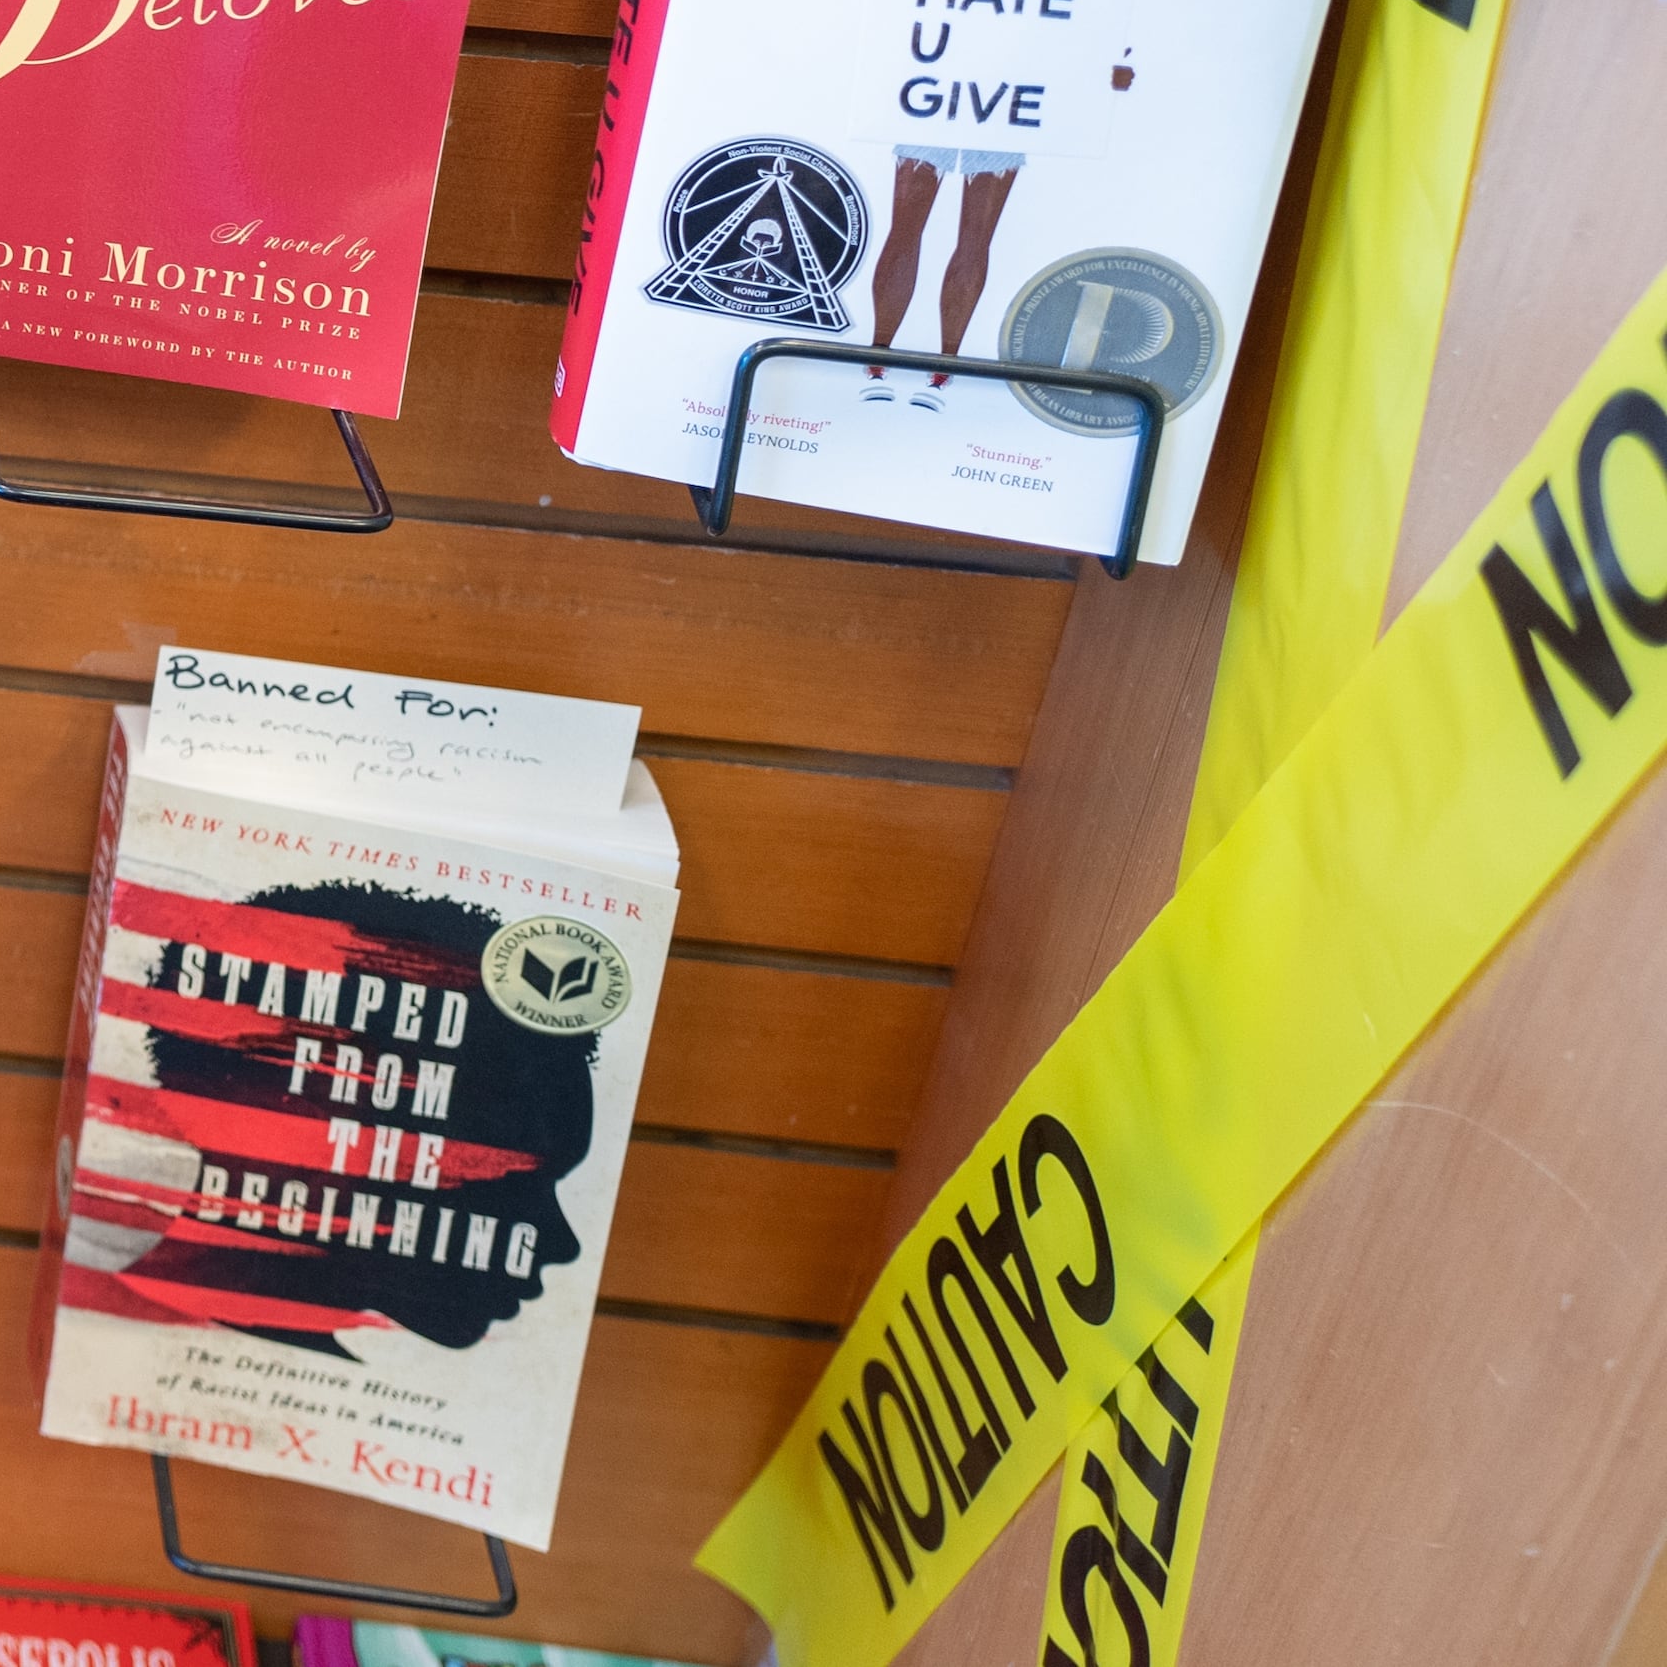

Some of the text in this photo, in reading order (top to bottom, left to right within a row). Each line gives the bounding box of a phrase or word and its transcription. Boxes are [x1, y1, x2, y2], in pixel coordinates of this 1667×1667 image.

[910, 22, 950, 64] U
[898, 78, 1045, 128] GIVE
[66, 289, 95, 303] OF
[112, 294, 161, 311] THE
[179, 303, 262, 326] NOBEL
[282, 317, 362, 340] PRIZE
[99, 241, 371, 317] Morrison
[951, 465, 1054, 493] JOHN GREEN
[166, 655, 499, 728] Banned For:
[159, 808, 645, 922] NEW YORK TIMES BESTSELLER
[177, 943, 468, 1049] STAMPED
[288, 1036, 457, 1121] FROM
[326, 1117, 445, 1191] THE
[198, 1165, 537, 1278] BEGINNING
[818, 1112, 1116, 1615] CAUTION
[107, 1394, 494, 1509] Ibram X. Kendi
